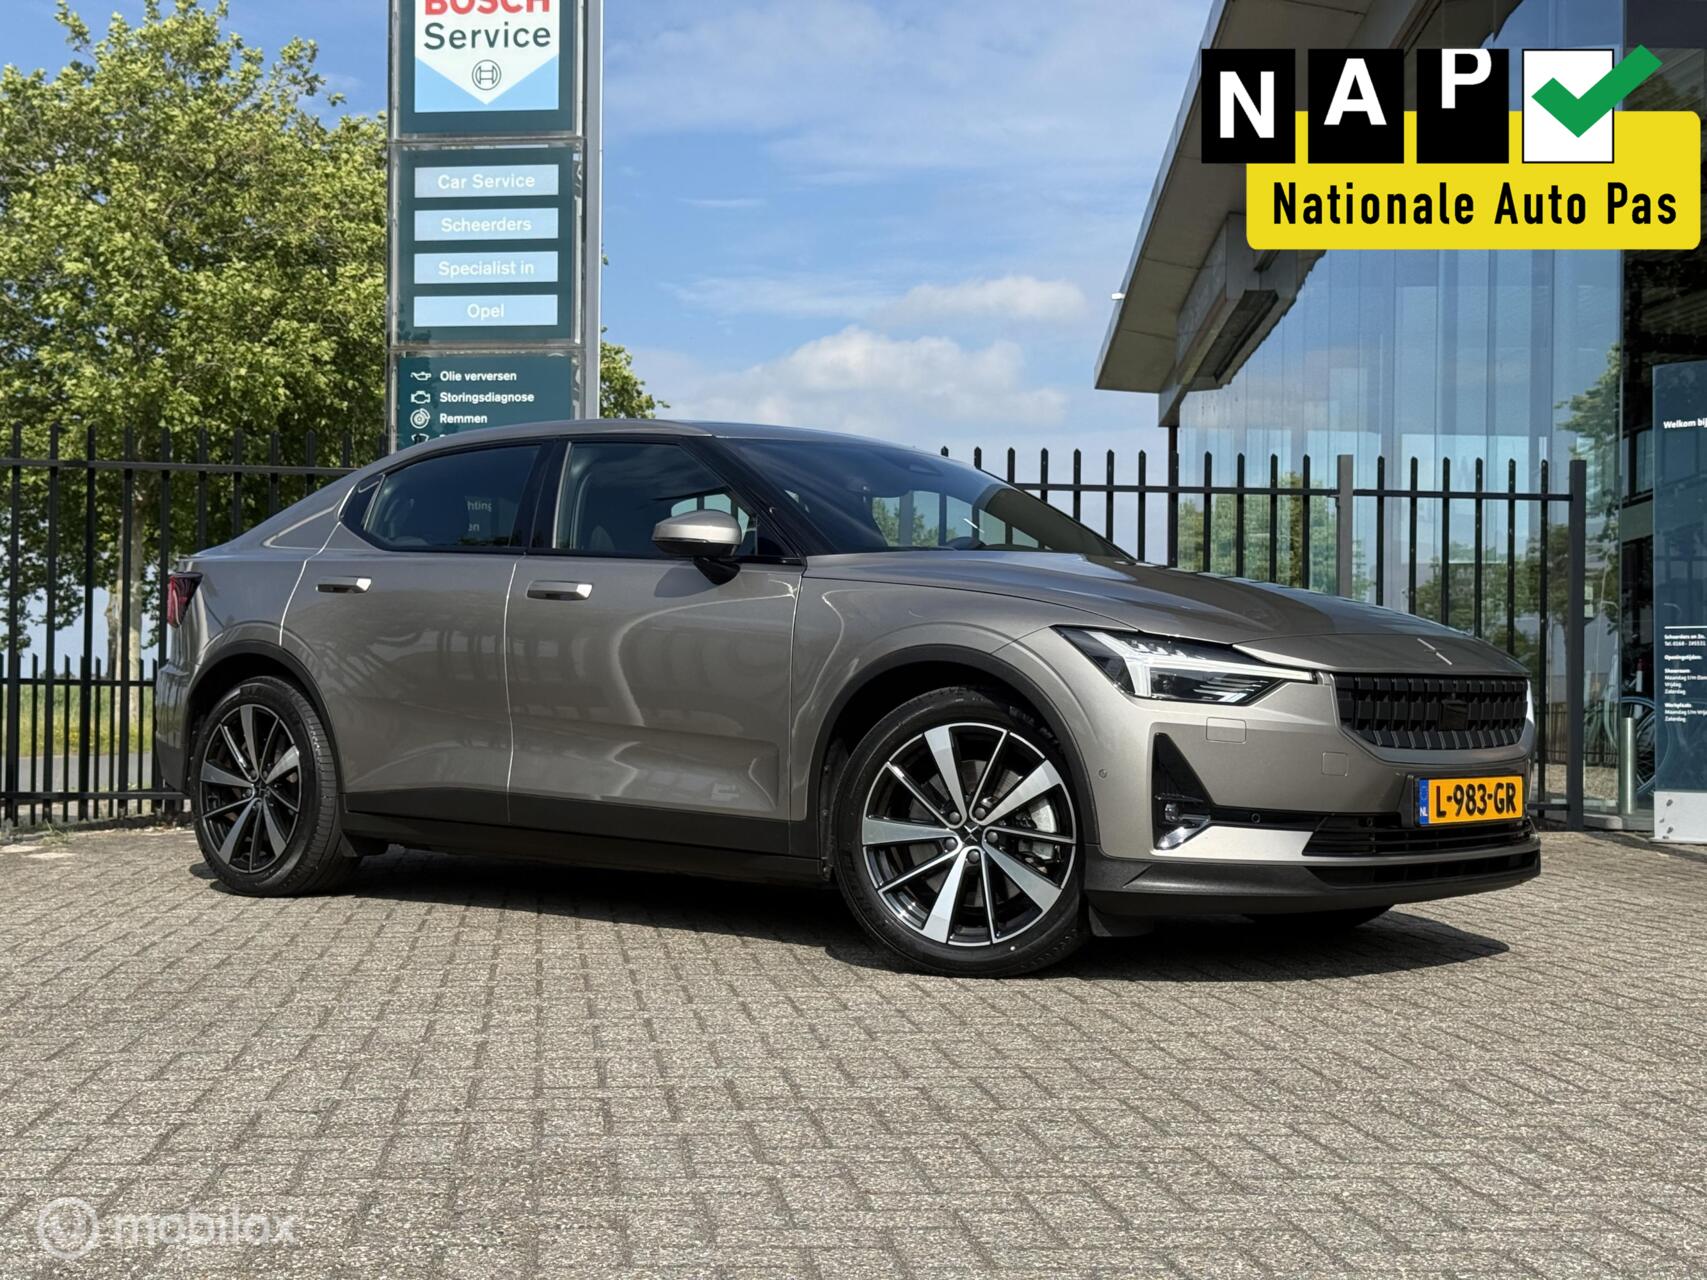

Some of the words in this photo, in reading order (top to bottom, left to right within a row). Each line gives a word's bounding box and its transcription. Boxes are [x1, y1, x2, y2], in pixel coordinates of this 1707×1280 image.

[424, 21, 551, 50] Service
[437, 174, 466, 189] Car
[472, 173, 536, 189] Service
[441, 217, 532, 232] Scheerders
[438, 261, 516, 278] Specialist
[520, 260, 535, 275] in
[467, 303, 505, 320] Opel
[440, 370, 462, 382] Olie
[465, 371, 517, 382] verversen
[440, 391, 535, 404] Storingsdiagnose
[440, 413, 488, 424] Remmen
[1663, 418, 1696, 429] Welkom
[1419, 806, 1428, 817] NL
[1435, 782, 1517, 818] L-983-GR
